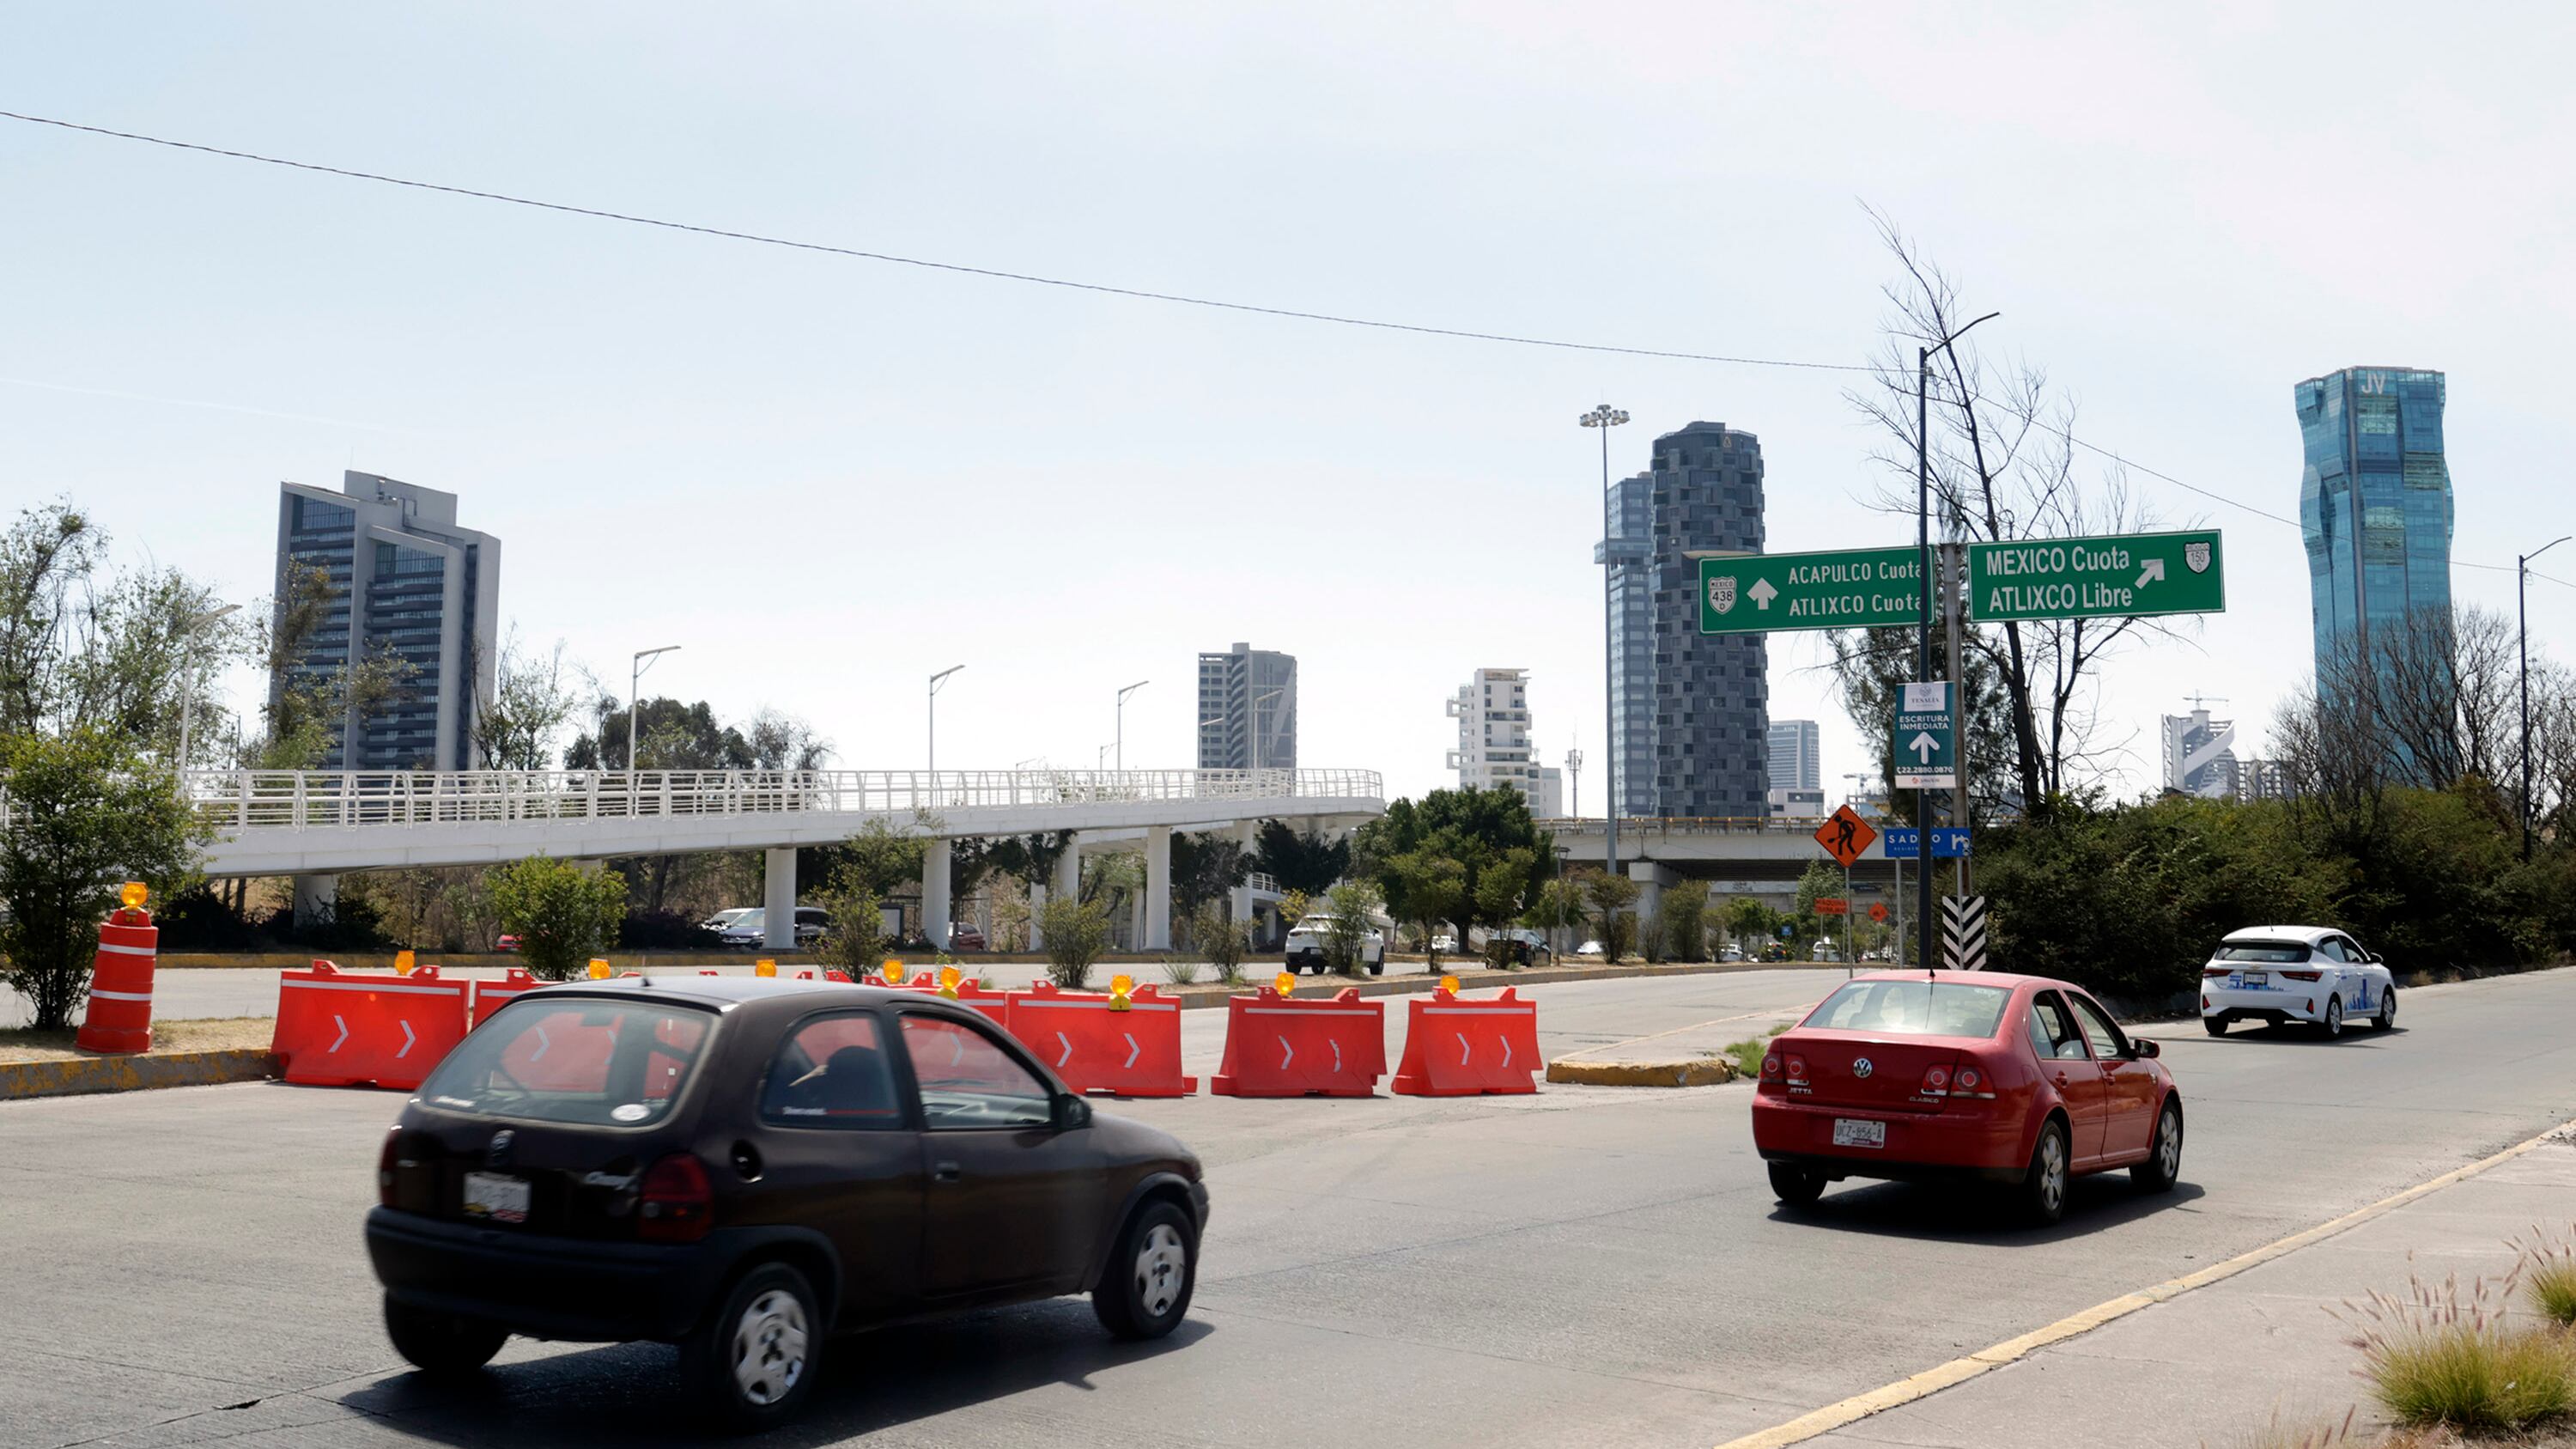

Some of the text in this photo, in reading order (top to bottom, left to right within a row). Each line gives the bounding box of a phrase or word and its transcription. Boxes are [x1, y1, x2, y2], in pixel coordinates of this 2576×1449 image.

[2361, 373, 2386, 394] JV
[1986, 545, 2129, 575] MEXICO Cuota
[2191, 552, 2205, 563] 150
[1788, 563, 1871, 584] ACAPULCO
[1712, 590, 1733, 602] 438
[1989, 582, 2133, 612] ATLIXCO Libre
[1789, 595, 1864, 617] ATLIXCO
[1899, 715, 1950, 723] ESCRITURA
[1888, 834, 1941, 843] SADO
[1789, 1087, 1813, 1095] JETTA
[1909, 1095, 1939, 1104] CLASICO
[1836, 1124, 1882, 1141] UCZ-856-A
